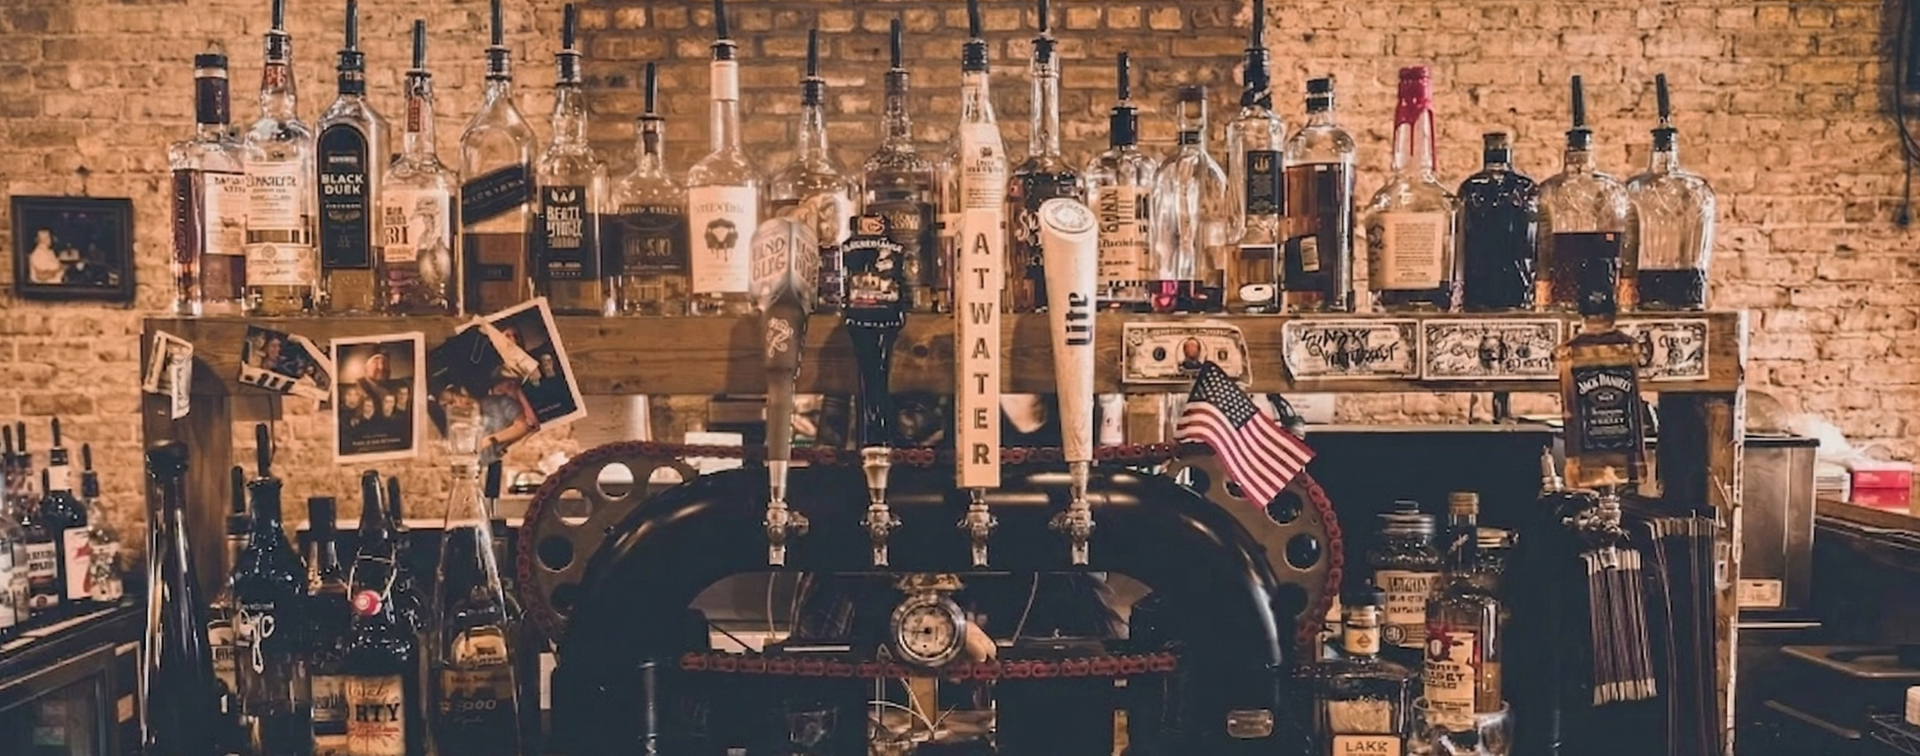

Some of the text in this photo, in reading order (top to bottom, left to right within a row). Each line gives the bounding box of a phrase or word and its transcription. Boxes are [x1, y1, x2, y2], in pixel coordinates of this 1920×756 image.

[321, 173, 364, 184] BLACK
[1065, 291, 1093, 347] Lite
[968, 232, 993, 465] ATWATER
[1577, 376, 1600, 395] JACK
